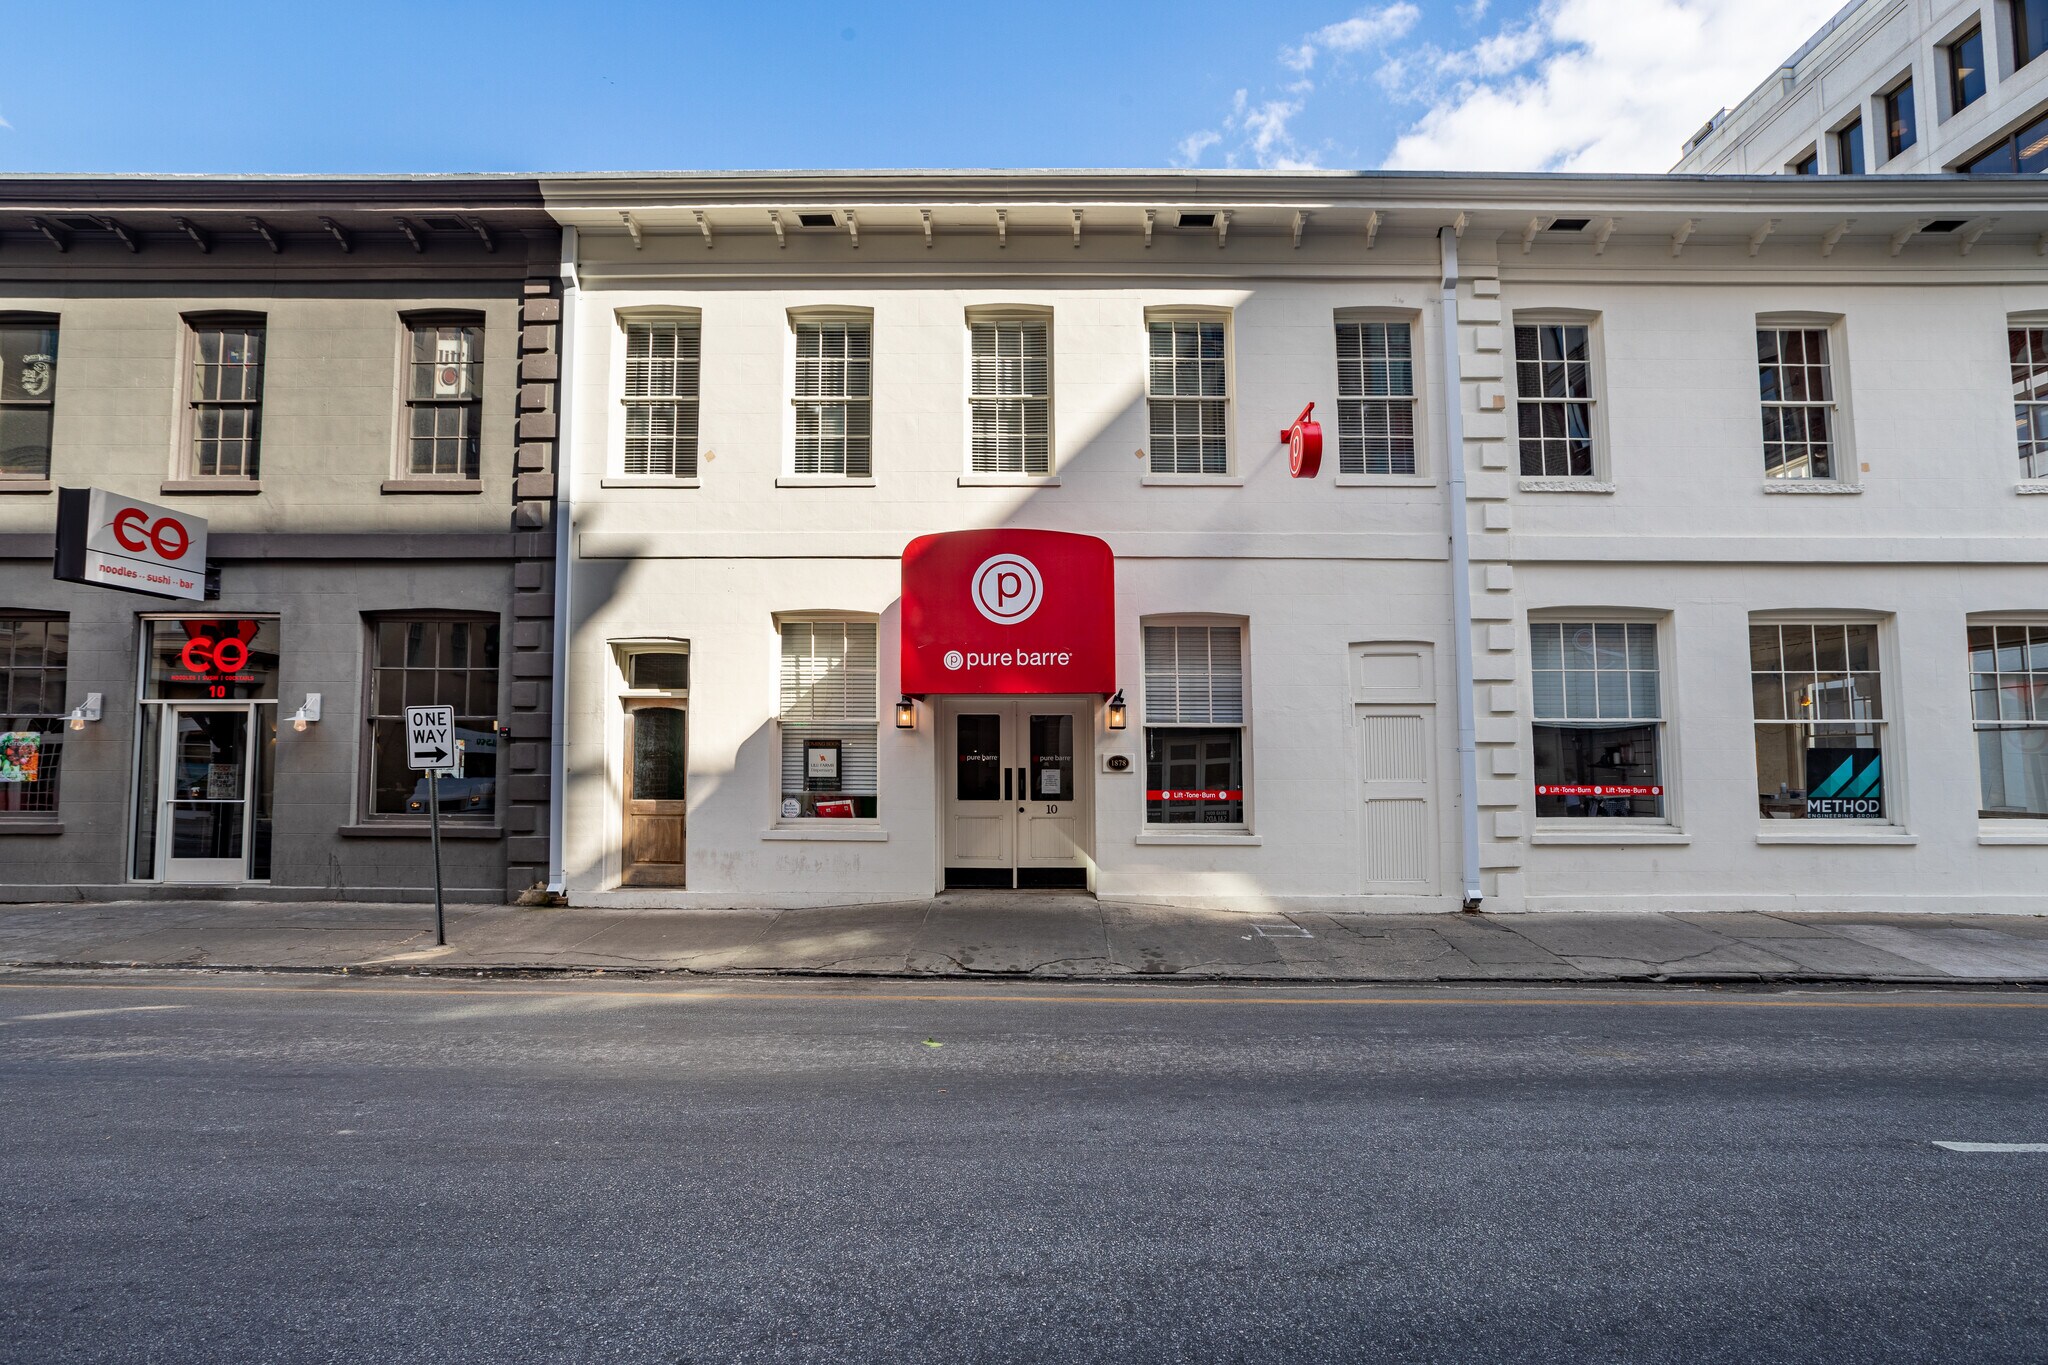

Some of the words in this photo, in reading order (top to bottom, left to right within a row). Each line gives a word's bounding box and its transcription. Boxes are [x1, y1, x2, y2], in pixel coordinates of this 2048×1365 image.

[113, 507, 189, 560] CO
[99, 564, 138, 579] noodles
[147, 573, 171, 585] sushi
[180, 578, 195, 589] bar
[182, 637, 249, 673] CO
[967, 652, 1013, 670] pure
[1016, 648, 1070, 666] barre
[209, 685, 226, 698] 10
[413, 712, 447, 727] ONE
[413, 729, 447, 744] WAY
[1111, 759, 1127, 767] 1878
[1046, 804, 1058, 814] 10
[1807, 800, 1880, 813] METHOD
